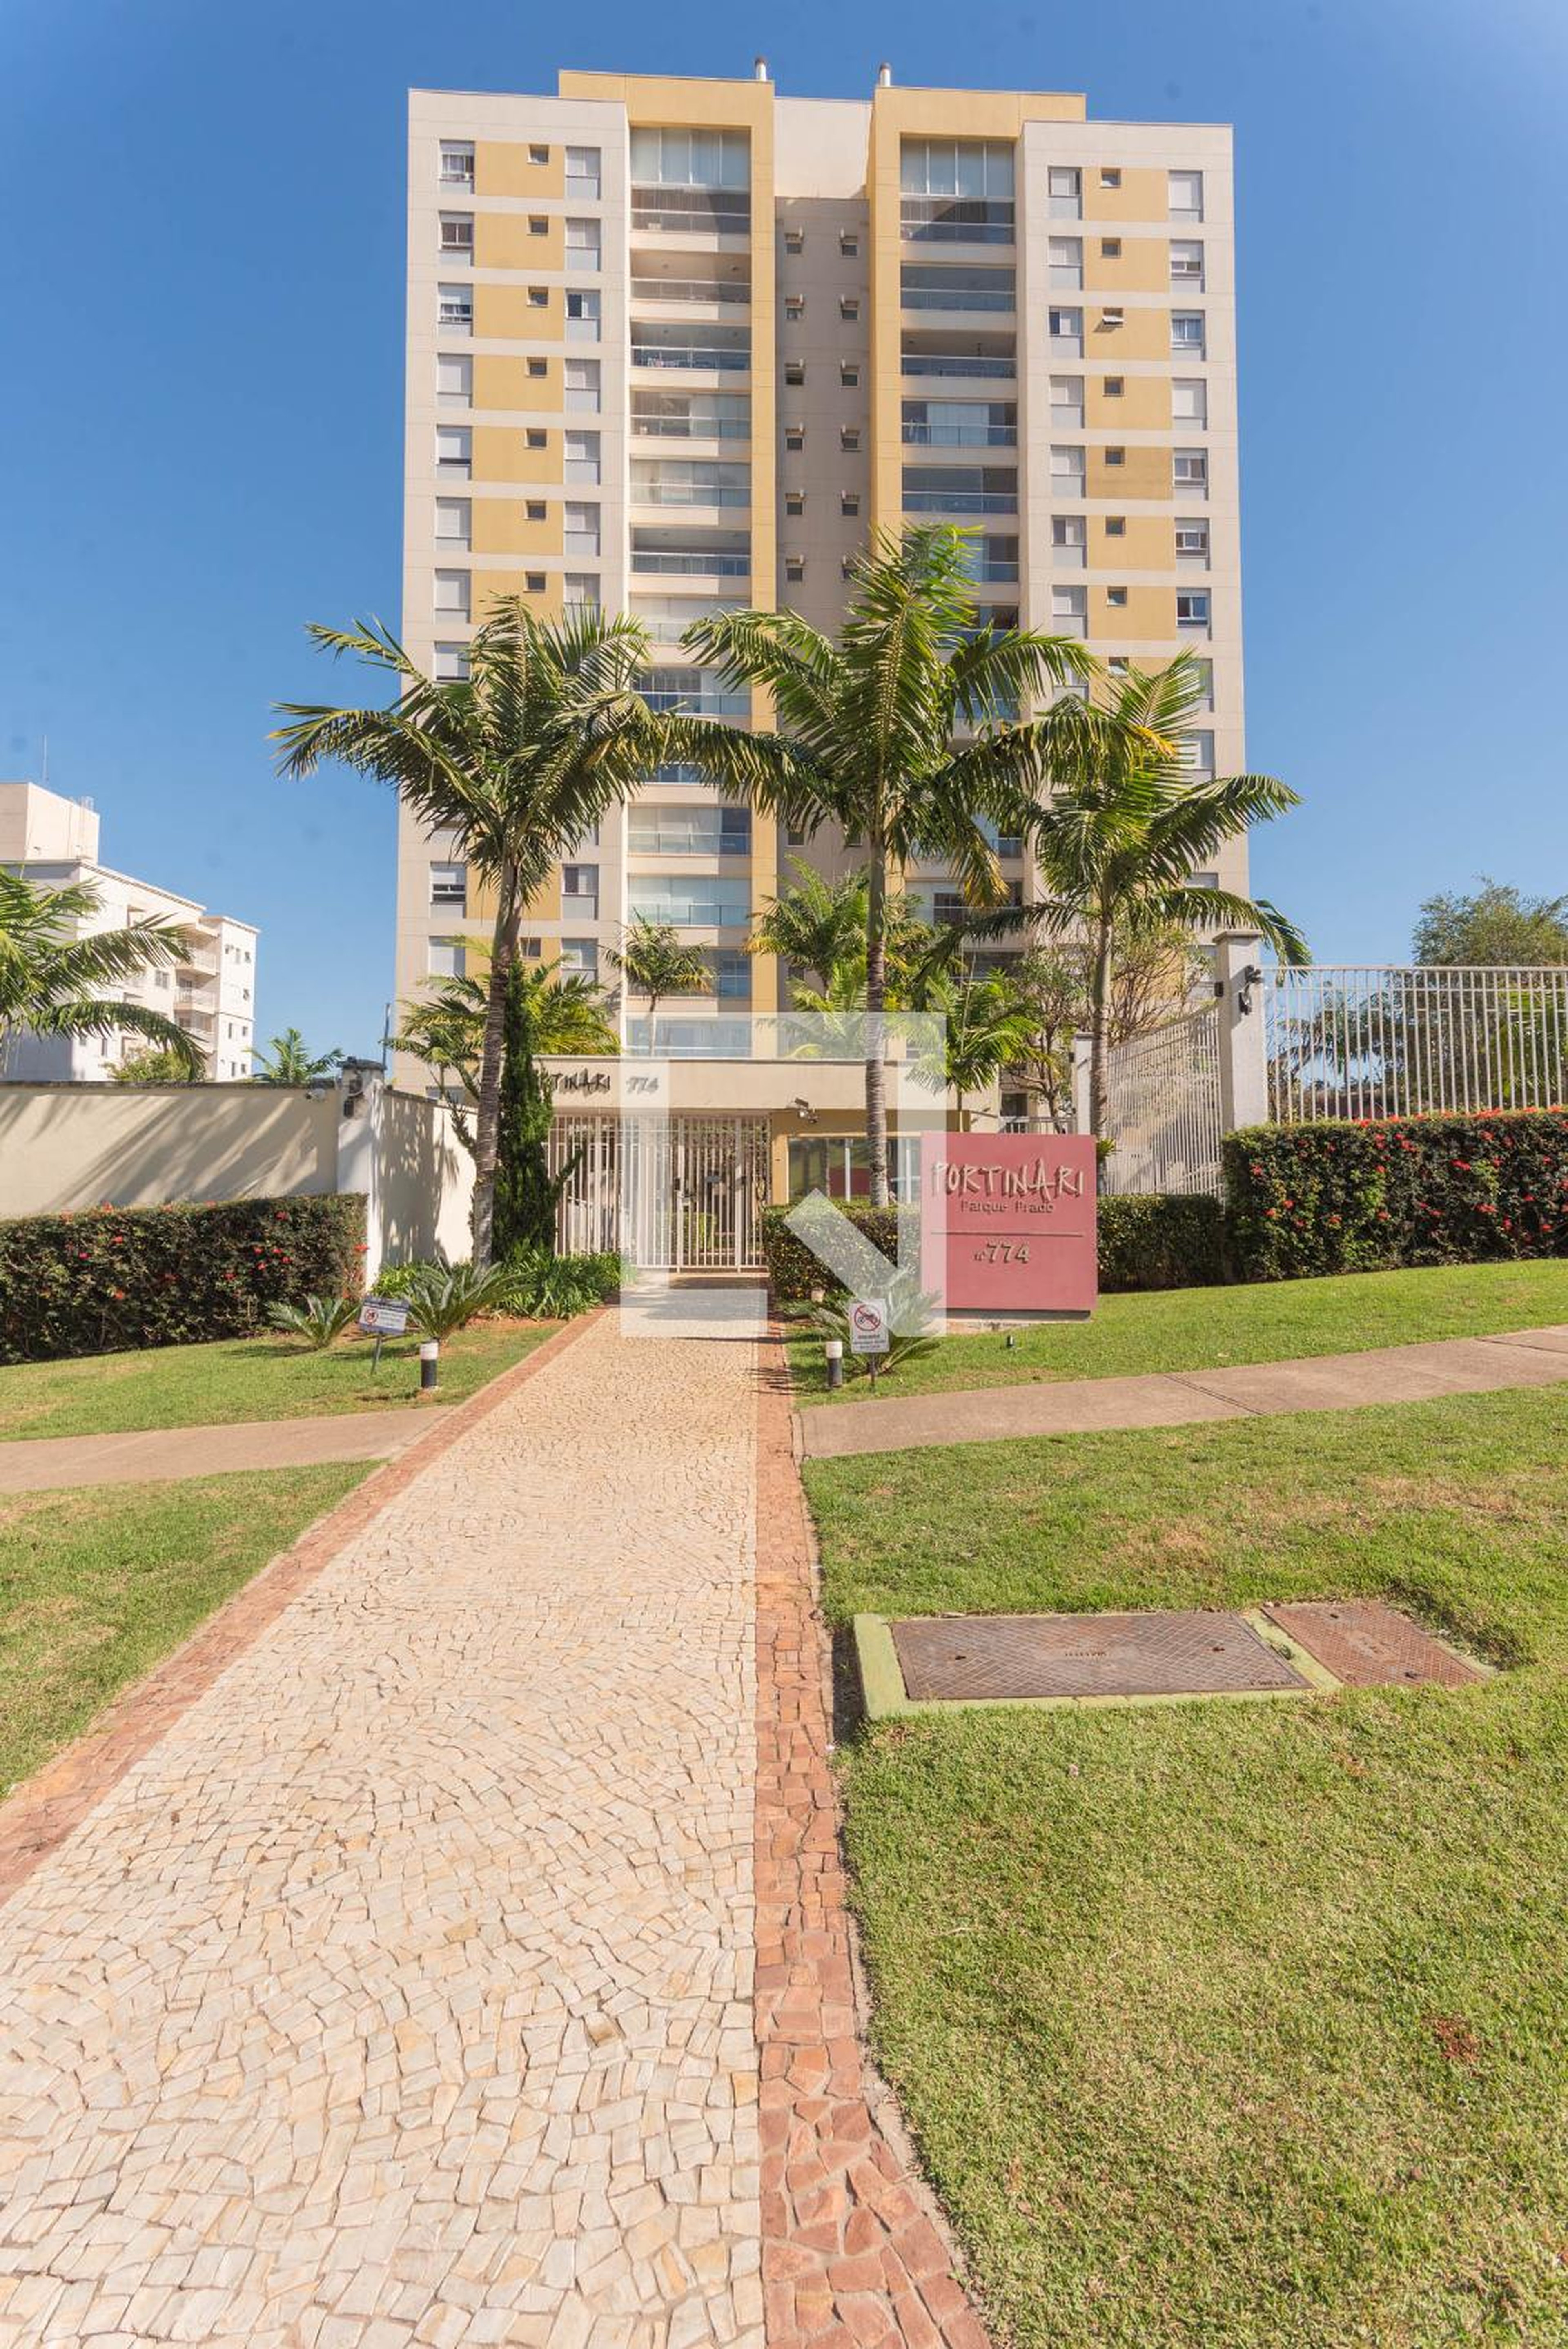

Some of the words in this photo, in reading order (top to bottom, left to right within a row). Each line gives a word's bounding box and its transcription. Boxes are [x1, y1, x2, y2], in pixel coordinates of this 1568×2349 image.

[542, 1067, 611, 1093] TINARI
[627, 1076, 659, 1092] 774
[933, 1157, 1084, 1202] PORTINARI
[961, 1200, 1009, 1215] Parque
[1015, 1200, 1054, 1213] Prado
